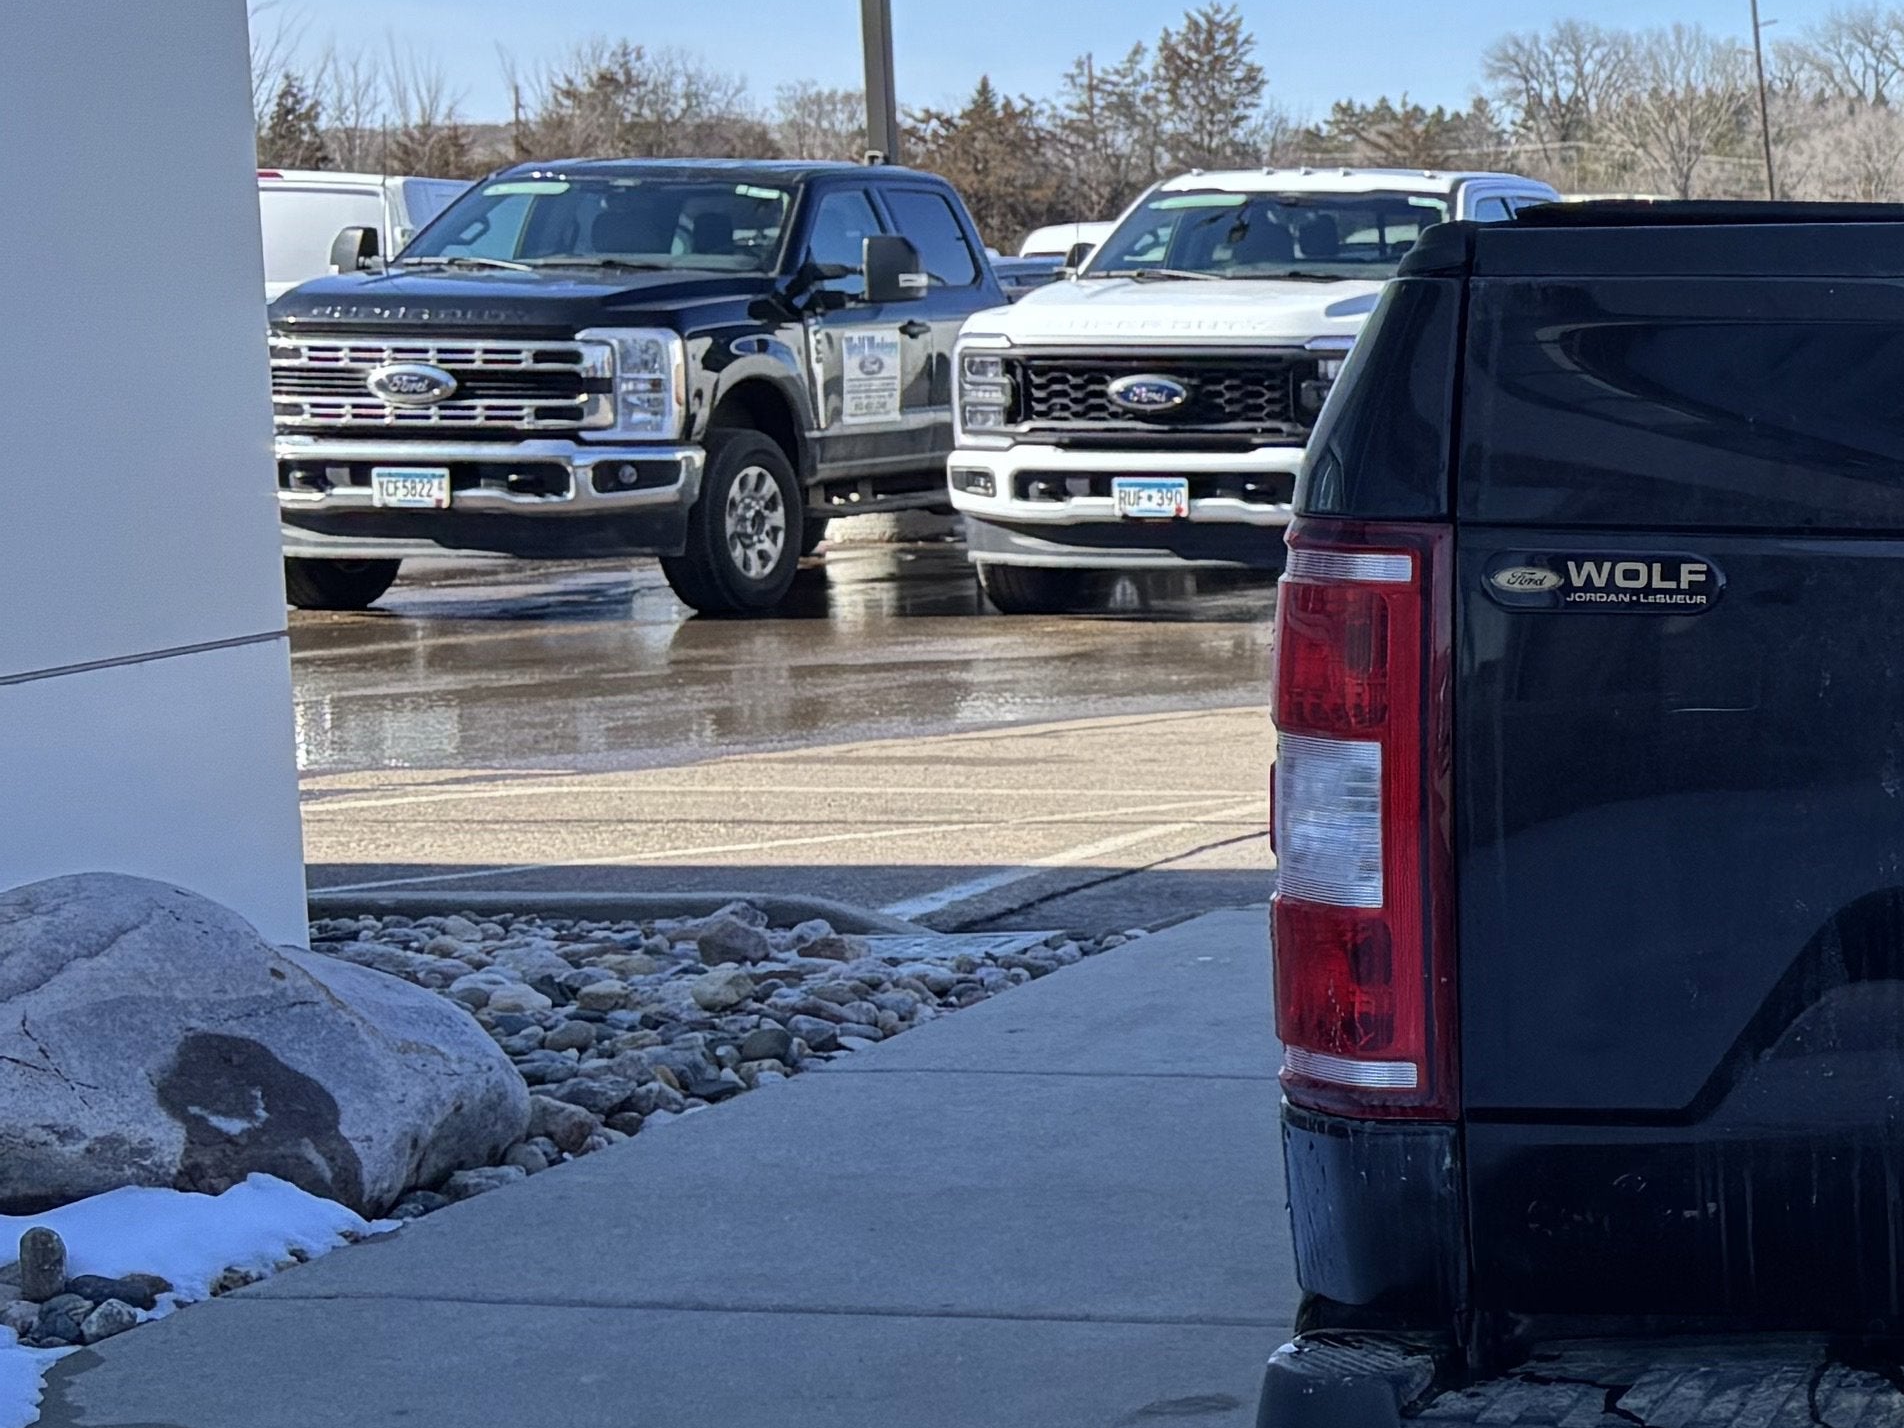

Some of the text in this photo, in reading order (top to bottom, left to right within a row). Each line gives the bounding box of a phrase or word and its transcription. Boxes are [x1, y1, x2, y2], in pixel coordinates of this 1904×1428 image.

[388, 375, 430, 393] Ford
[378, 479, 433, 498] YCF5822
[1567, 561, 1708, 590] WOLF
[1566, 592, 1630, 603] JORDAN
